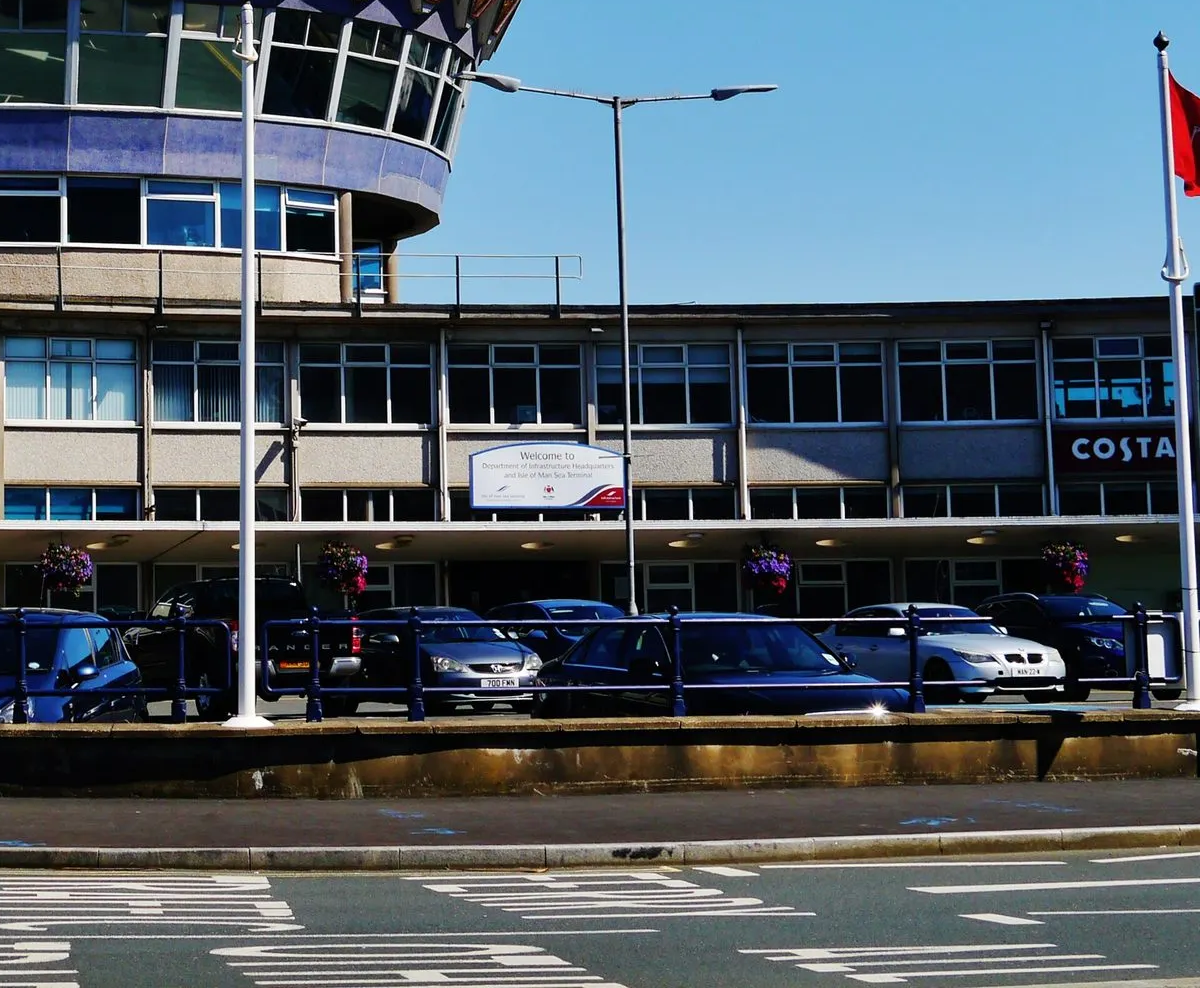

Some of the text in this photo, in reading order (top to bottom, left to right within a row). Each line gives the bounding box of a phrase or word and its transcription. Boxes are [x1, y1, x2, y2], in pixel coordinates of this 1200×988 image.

[520, 451, 575, 461] Welcome to
[1071, 436, 1176, 462] COSTA
[482, 462, 519, 470] Department
[528, 462, 571, 470] Infrastructure
[572, 462, 615, 470] Headquarters
[400, 872, 820, 919] FERRY
[736, 943, 1160, 983] ALL
